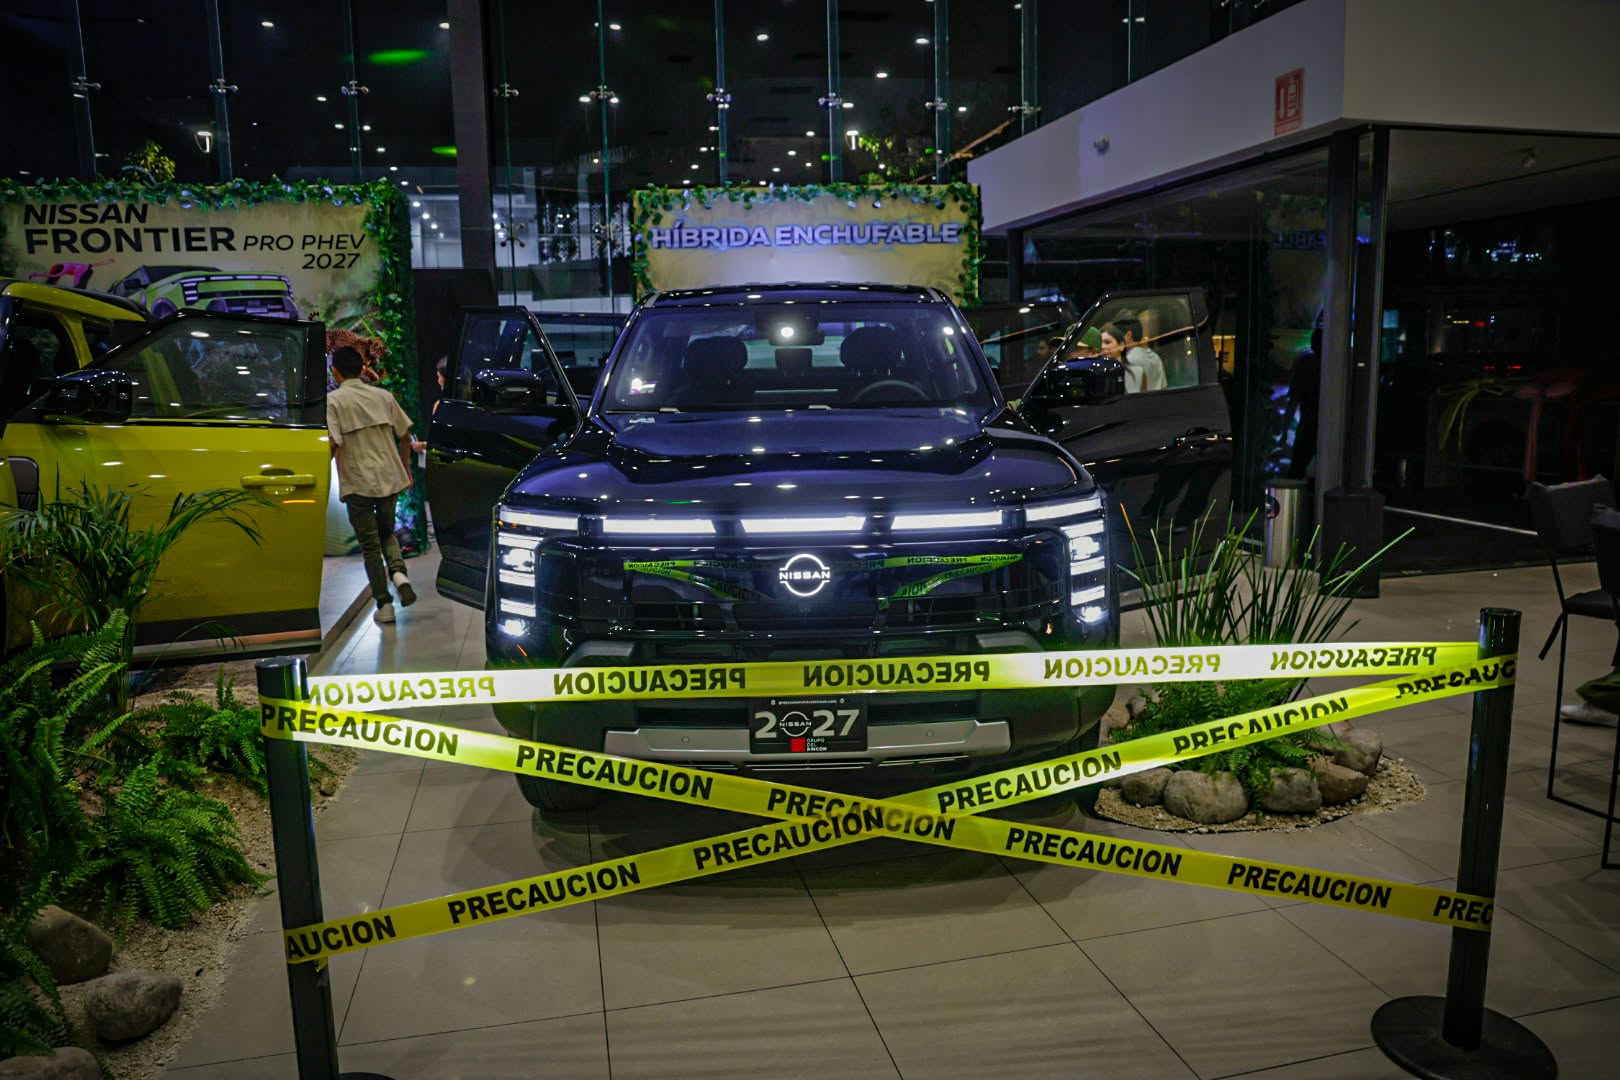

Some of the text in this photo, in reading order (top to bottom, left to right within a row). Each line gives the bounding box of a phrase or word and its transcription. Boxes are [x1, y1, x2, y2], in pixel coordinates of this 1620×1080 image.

[23, 203, 148, 225] NISSAN
[25, 226, 366, 254] FRONTIER PRO PHEV
[650, 219, 963, 249] HÍBRIDA ENCHUFABLE
[301, 252, 361, 270] 2027
[779, 570, 831, 581] NISSAN
[261, 702, 459, 757] PRECAUCION
[516, 744, 714, 801] PRECAUCION
[1005, 827, 1183, 877] PRECAUCION
[1227, 862, 1393, 909] PRECAUCION
[1432, 895, 1494, 926] PREC
[447, 861, 641, 925] PRECAUCION
[693, 806, 885, 871] PRECAUCION
[937, 750, 1123, 815] PRECAUCION
